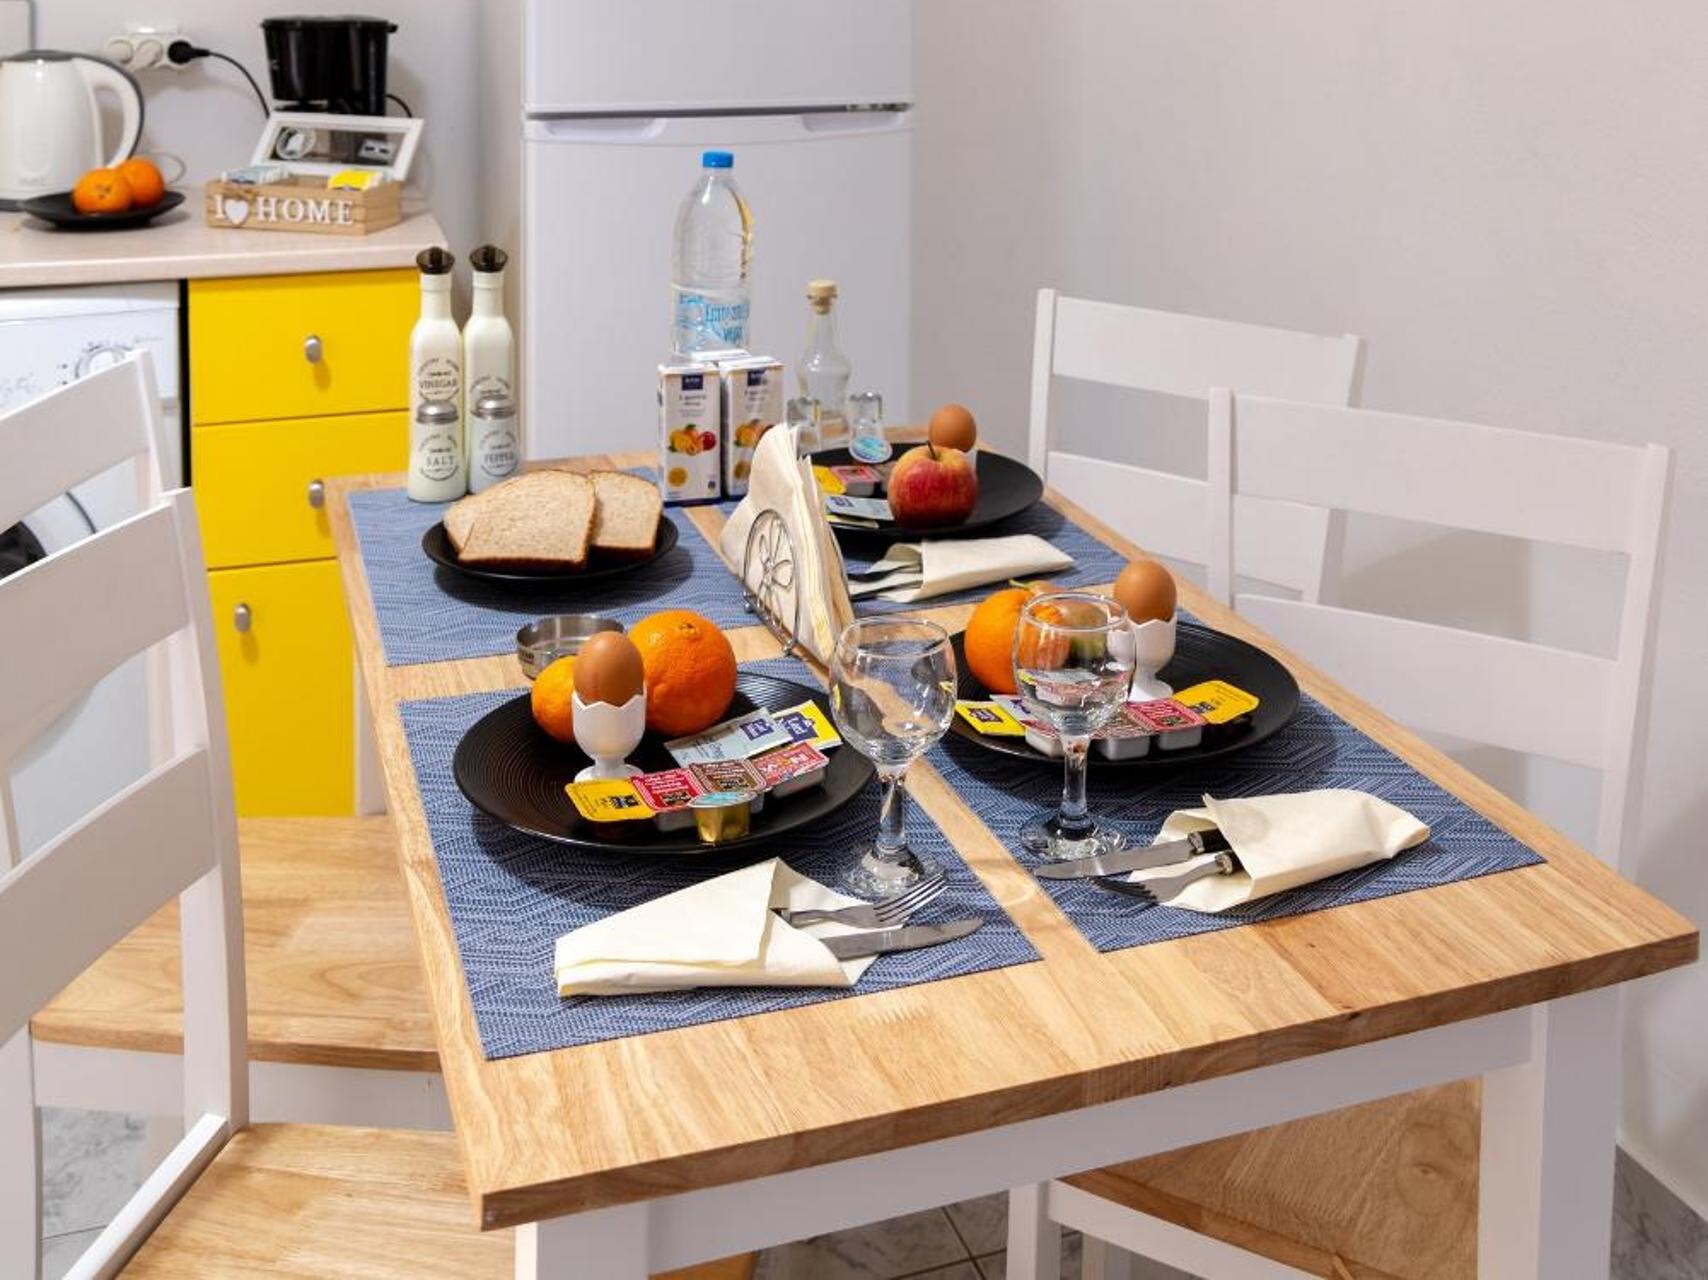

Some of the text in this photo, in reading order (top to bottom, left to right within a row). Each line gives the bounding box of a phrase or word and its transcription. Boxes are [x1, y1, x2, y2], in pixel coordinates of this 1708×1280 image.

[256, 196, 354, 225] HOME
[420, 379, 458, 390] VINEGAR
[426, 455, 454, 467] SALT
